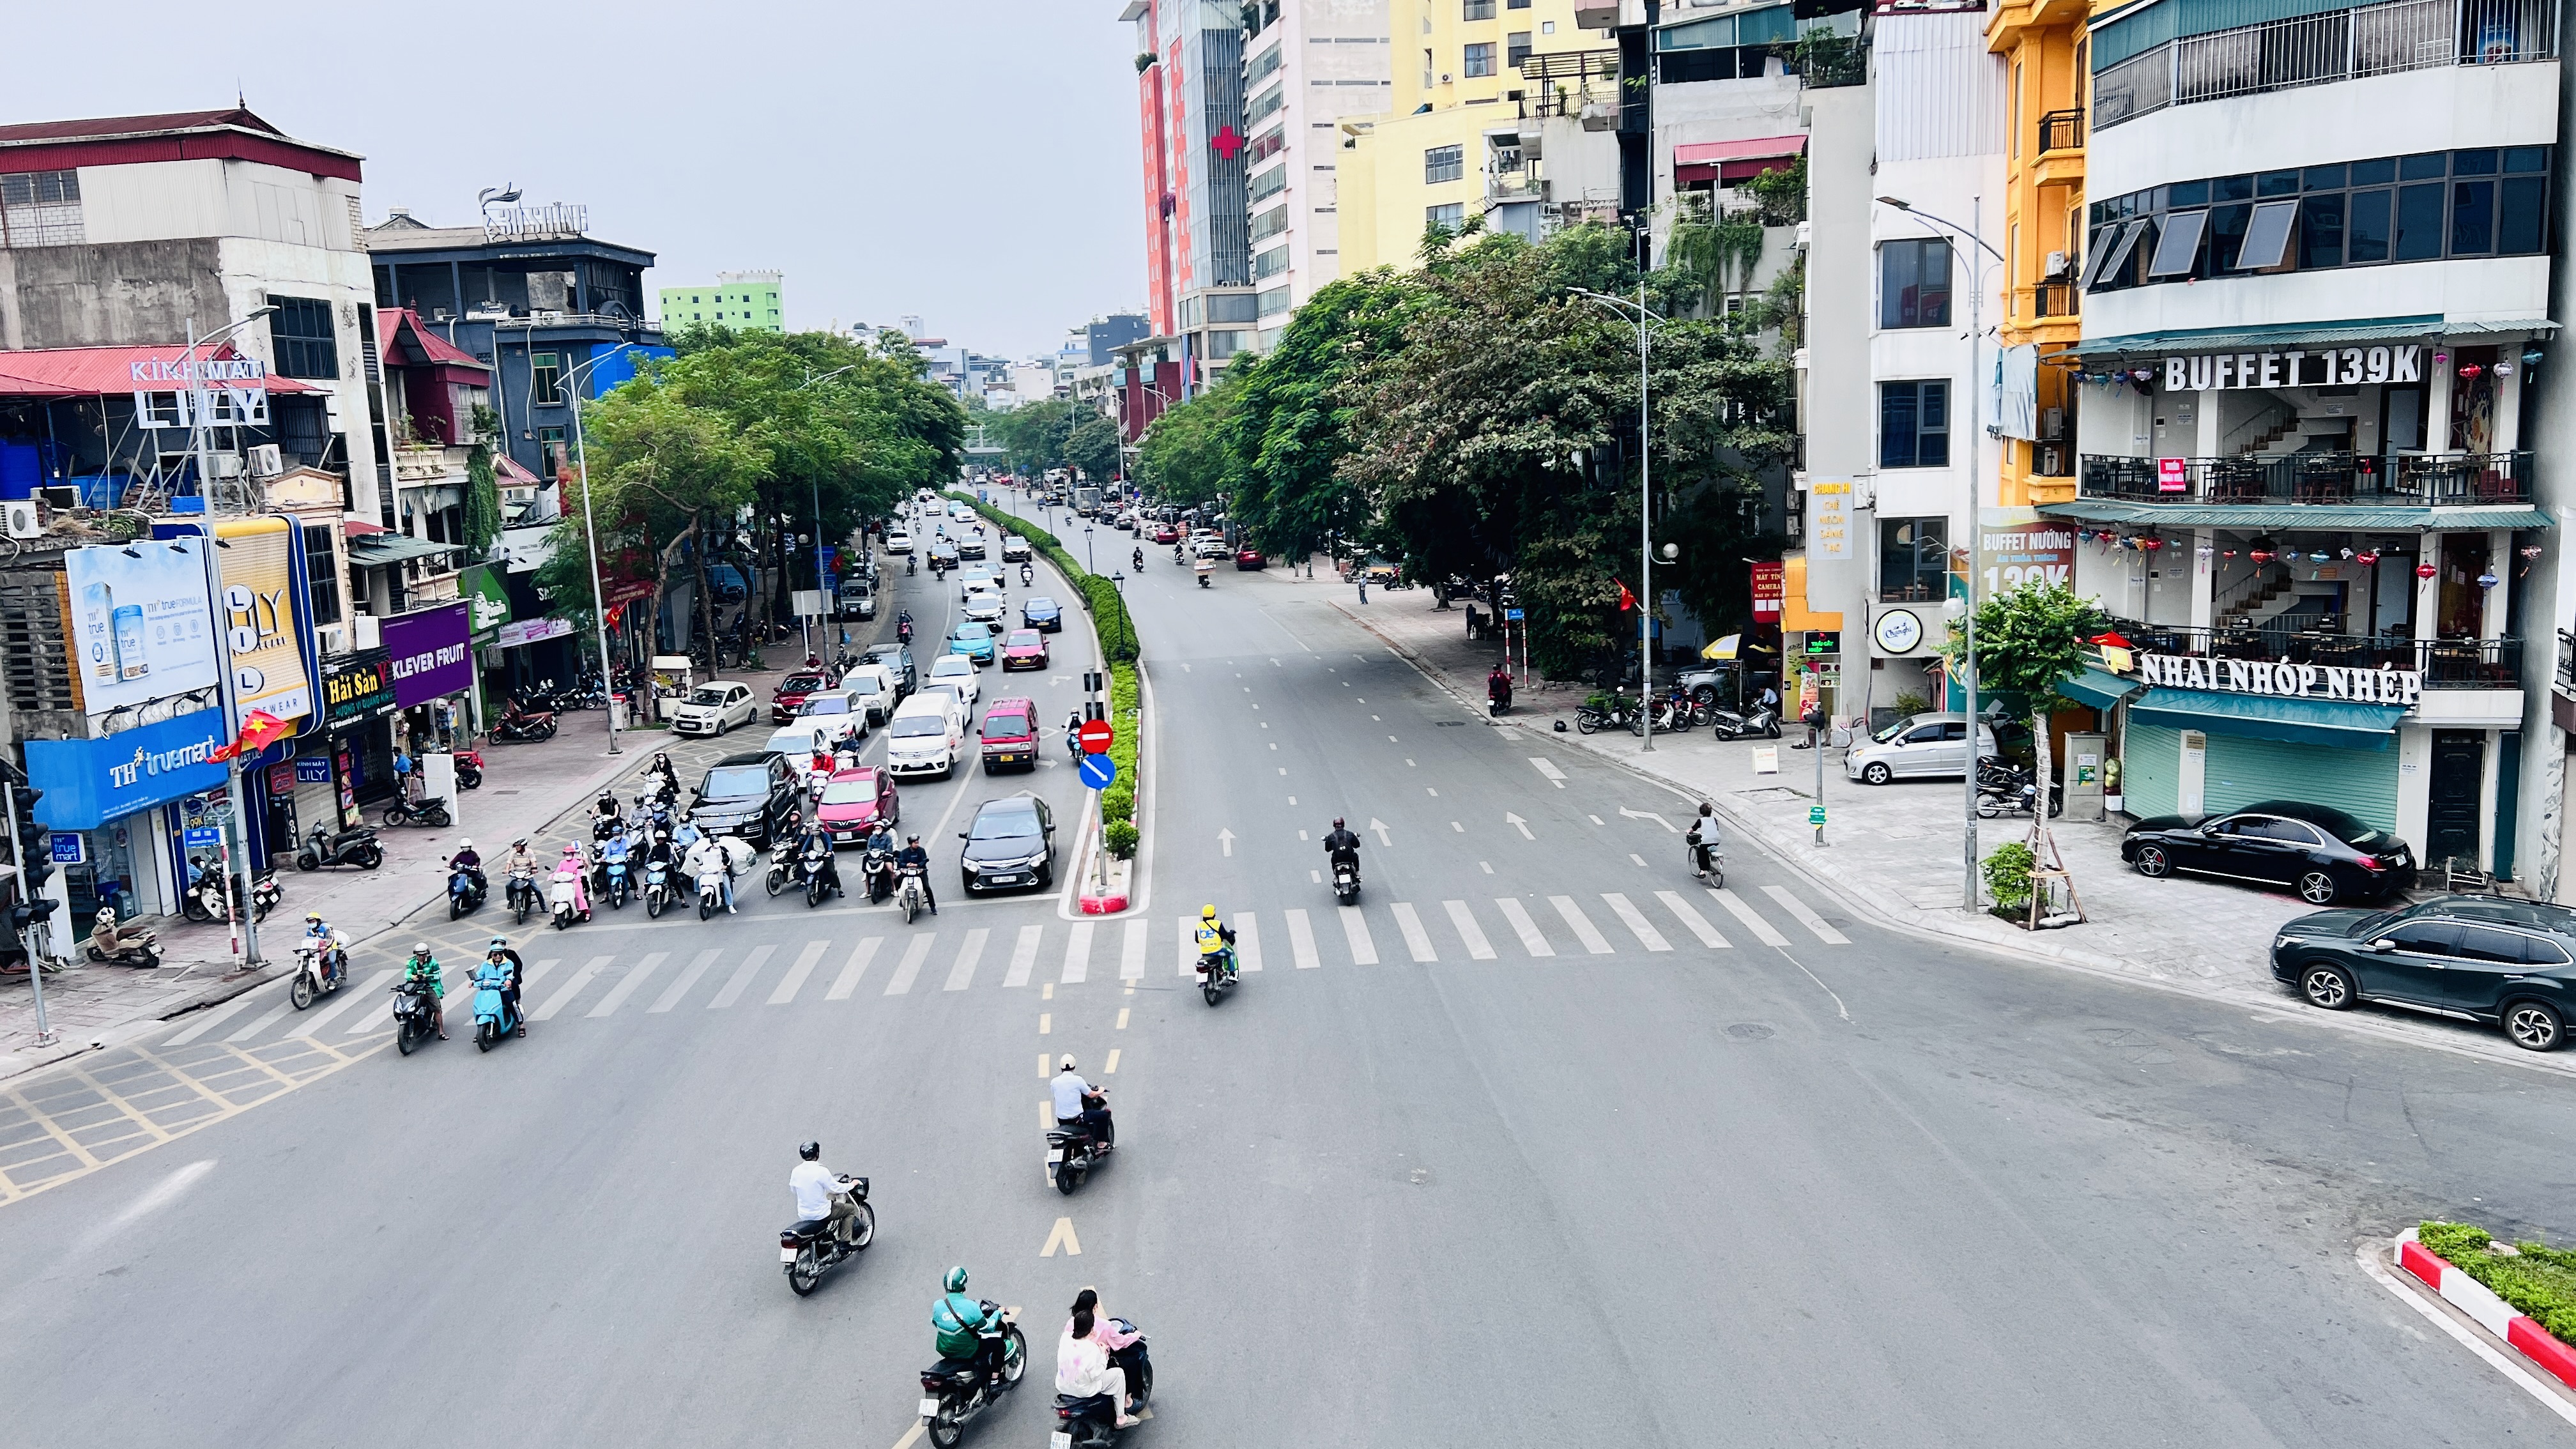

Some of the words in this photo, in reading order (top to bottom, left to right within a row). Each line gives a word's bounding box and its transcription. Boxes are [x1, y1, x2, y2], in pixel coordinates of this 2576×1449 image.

[2166, 350, 2305, 392] BUFFET
[2322, 344, 2421, 385] 139K
[134, 387, 263, 429] LILY
[1983, 533, 2027, 551] BUFFET
[2029, 528, 2071, 550] NƯỚNG
[1984, 564, 2069, 602] 139K
[88, 622, 104, 635] true
[120, 637, 135, 648] true
[392, 652, 434, 680] KLEVER
[436, 642, 465, 667] FRUIT
[328, 674, 353, 704] Hải
[354, 668, 378, 696] Sản
[2140, 654, 2220, 690] NHAI
[2227, 655, 2317, 697] NHÓP
[2325, 661, 2422, 704] NHÉP
[110, 762, 137, 788] TH
[298, 769, 326, 781] LILY
[54, 843, 76, 853] true
[56, 852, 77, 861] mart
[1199, 927, 1215, 939] be
